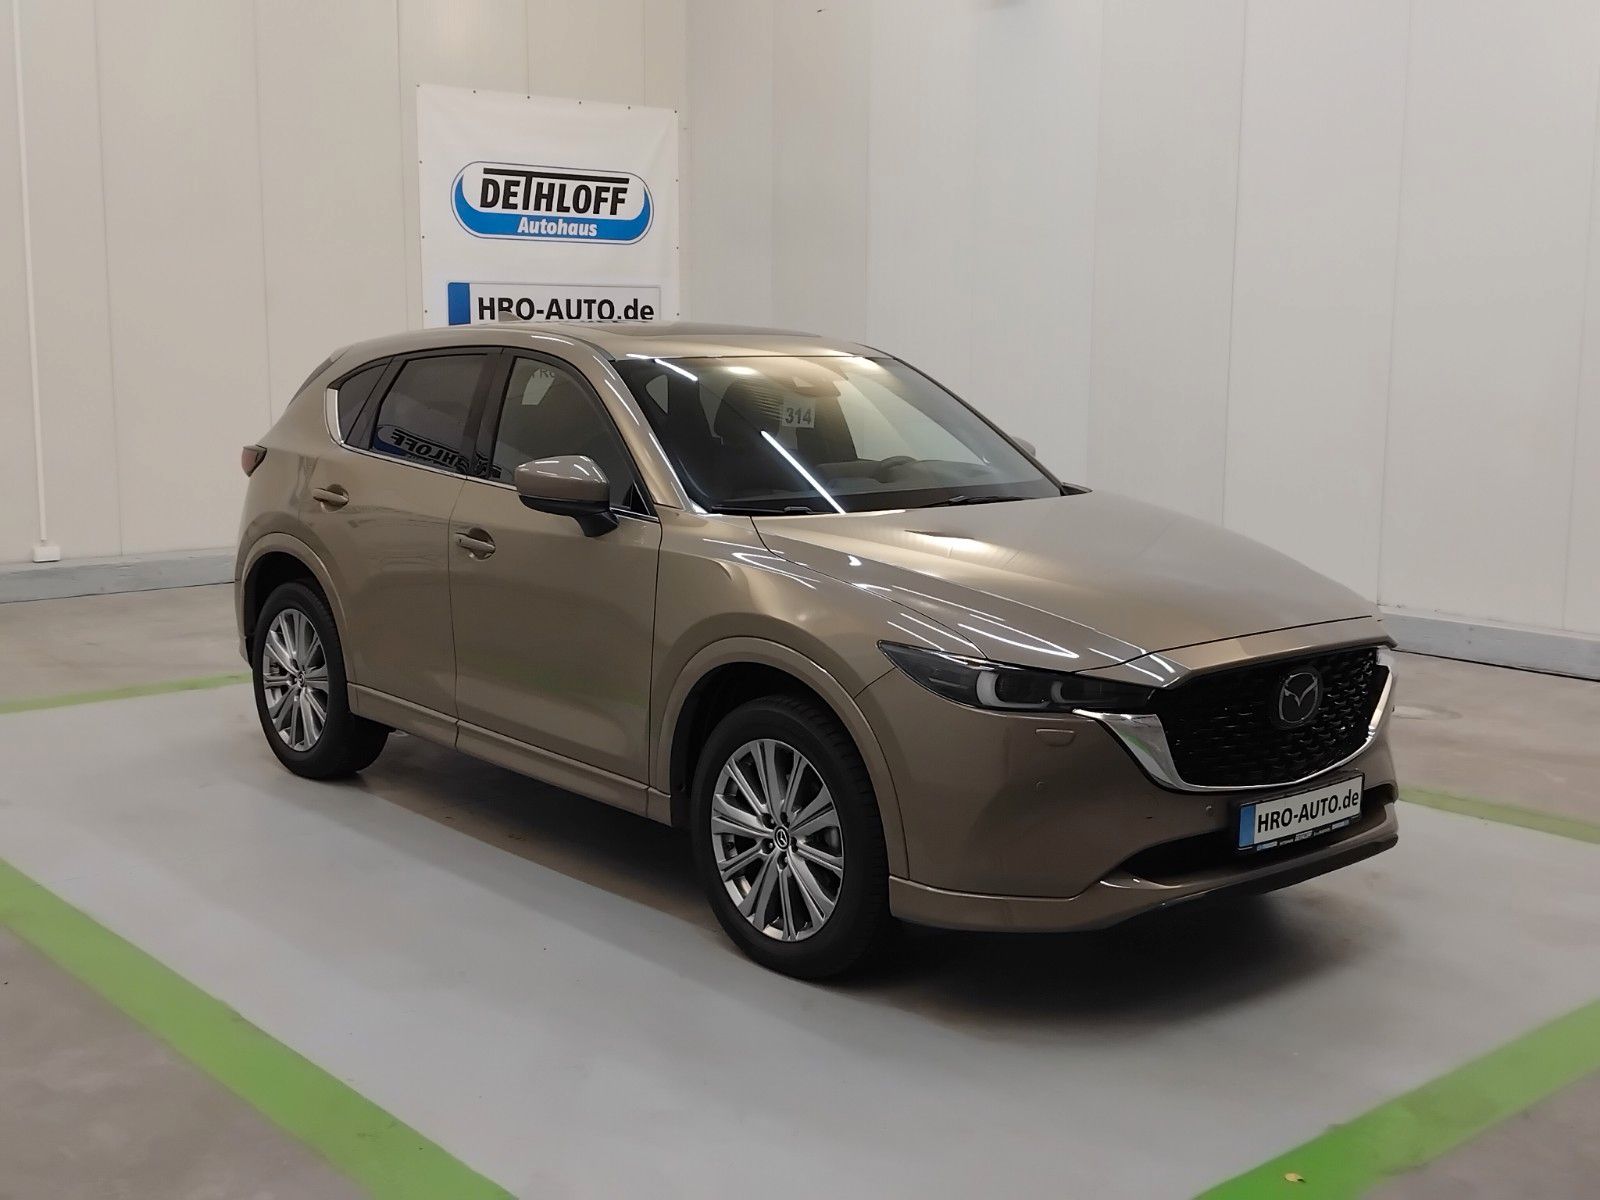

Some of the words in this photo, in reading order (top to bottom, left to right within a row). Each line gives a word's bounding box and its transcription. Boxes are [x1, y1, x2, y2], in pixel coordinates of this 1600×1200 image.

[479, 167, 630, 216] DETHLOFF
[517, 216, 598, 237] Autohaus
[477, 296, 655, 321] HRO-AUTO.de
[785, 406, 812, 424] 314
[1257, 788, 1359, 833] HRO-AUTO.de
